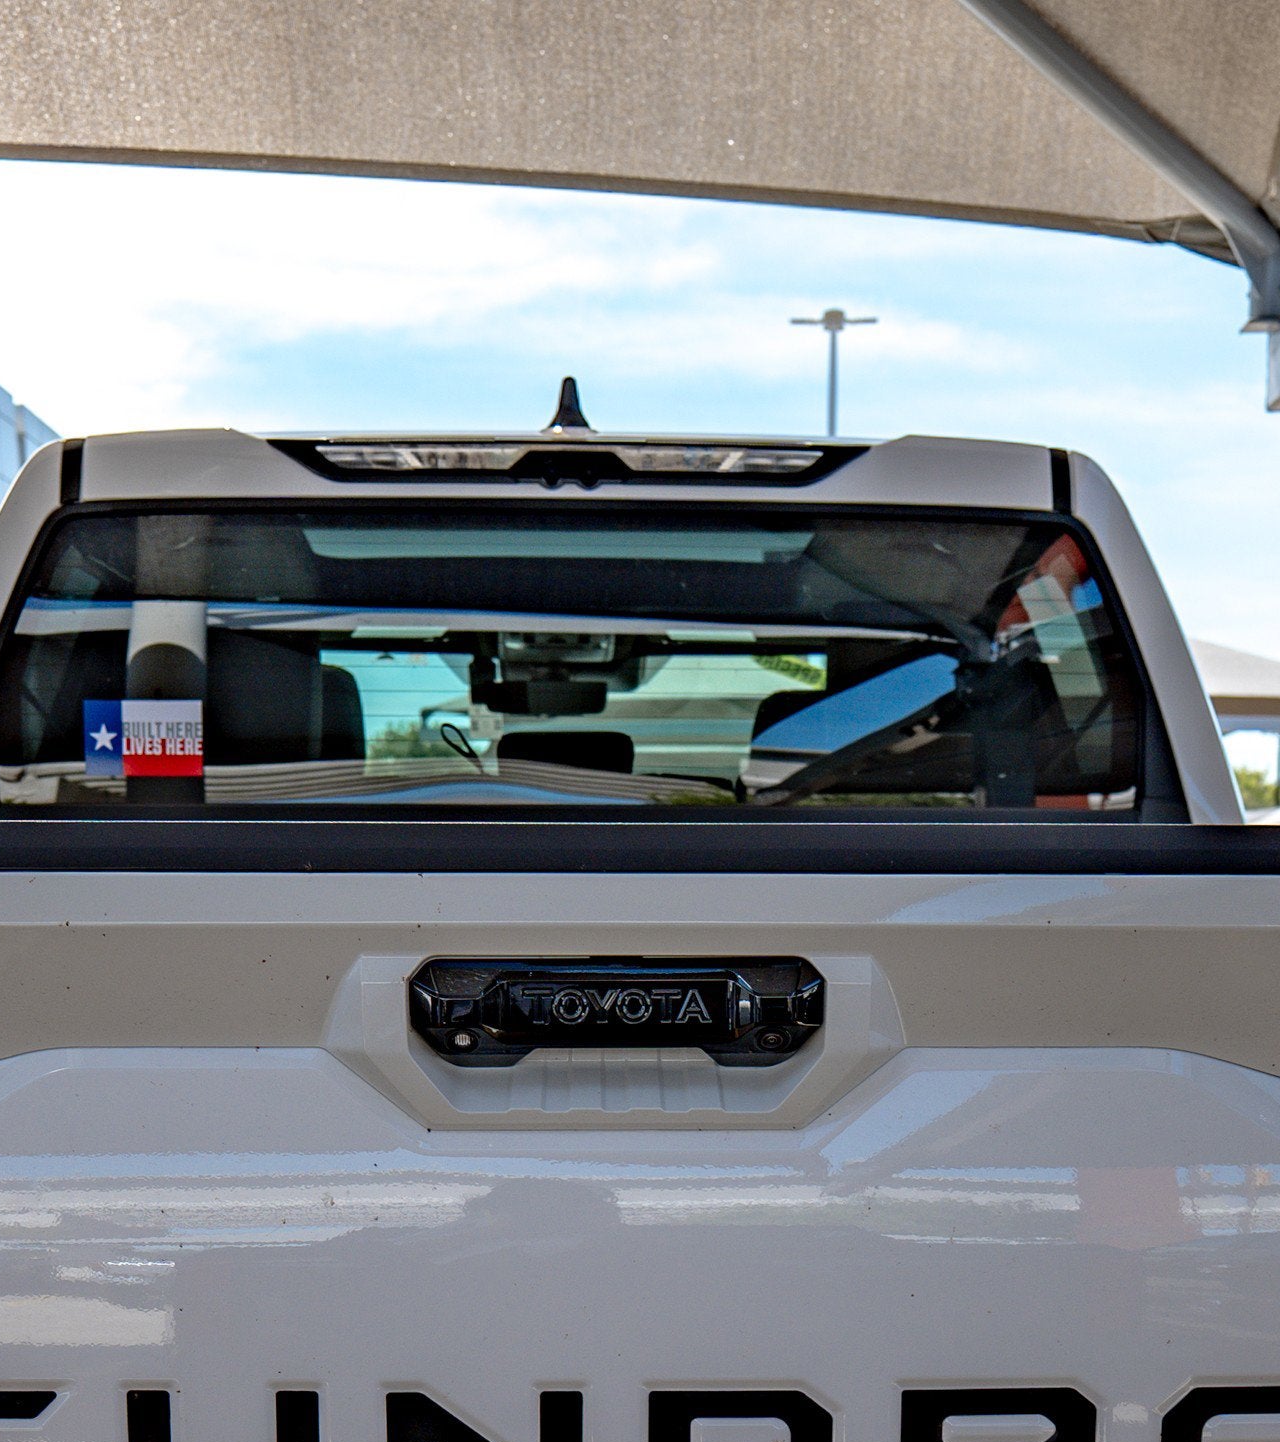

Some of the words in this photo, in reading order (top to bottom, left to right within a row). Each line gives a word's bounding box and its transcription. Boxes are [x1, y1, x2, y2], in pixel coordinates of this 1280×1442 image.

[123, 722, 163, 738] BUILT
[166, 722, 202, 738] HERE
[122, 738, 162, 755] LIVES
[165, 739, 203, 755] HERE
[521, 988, 713, 1024] TOYOTA
